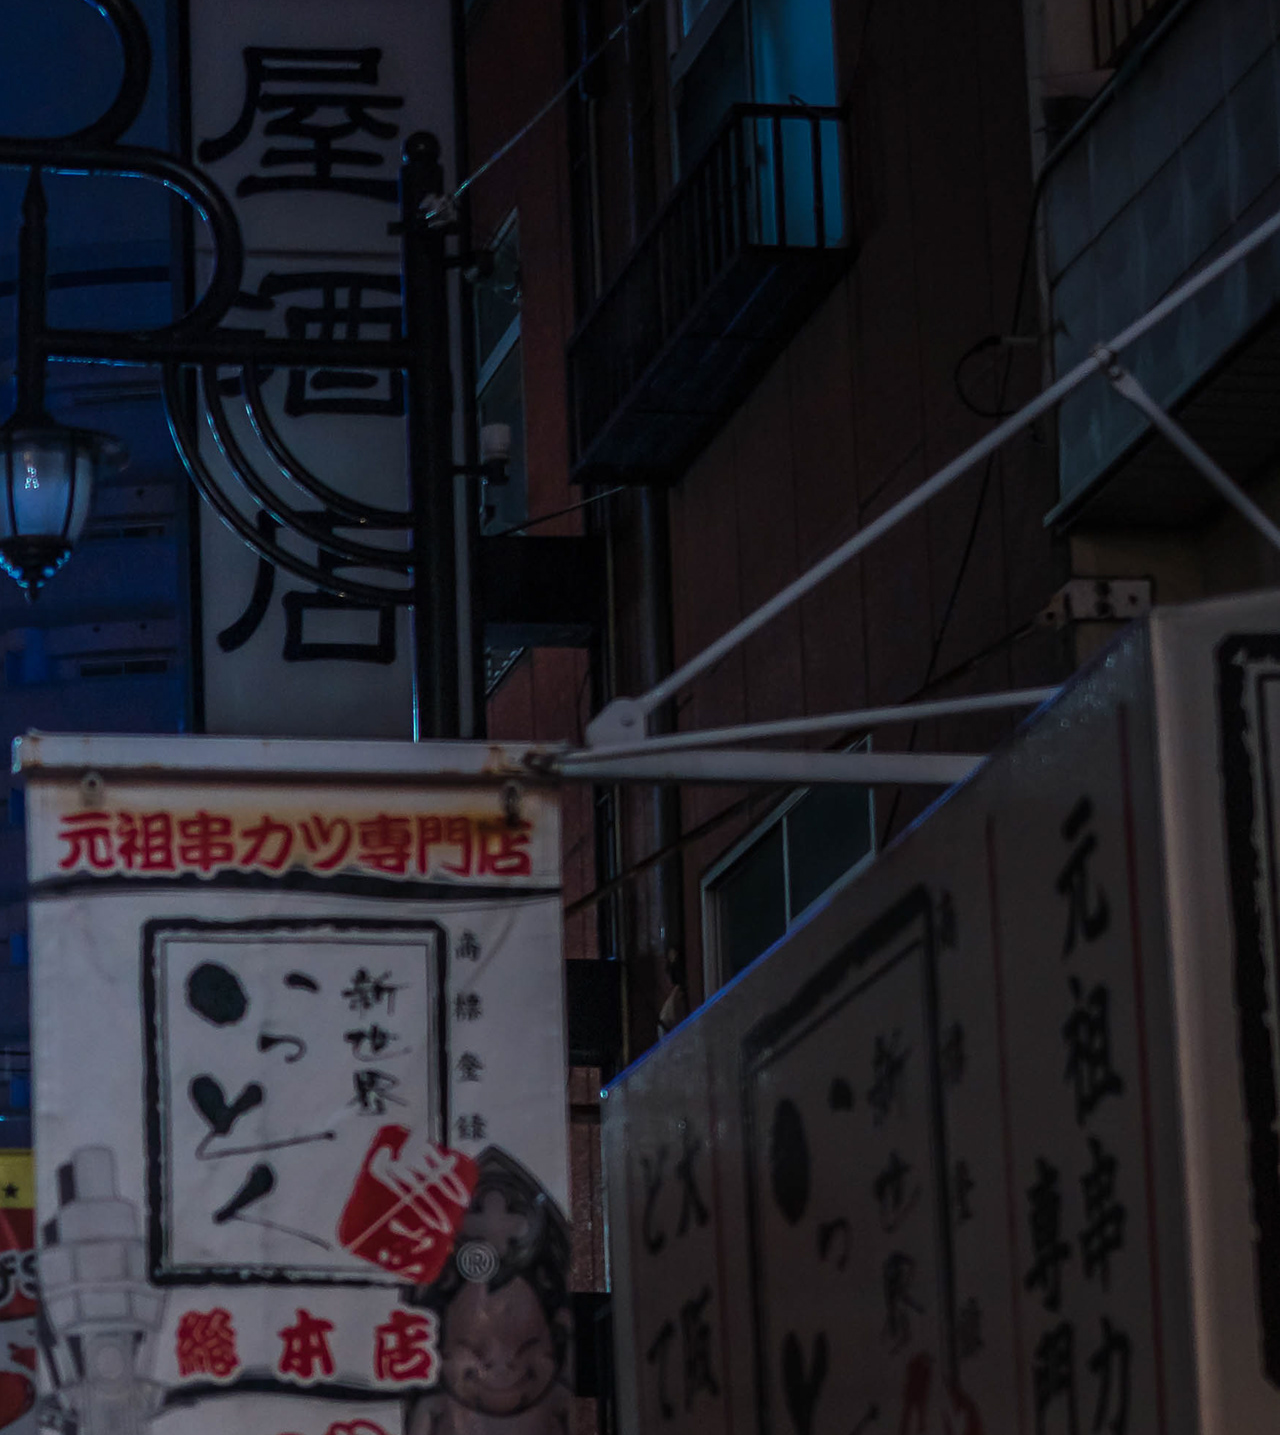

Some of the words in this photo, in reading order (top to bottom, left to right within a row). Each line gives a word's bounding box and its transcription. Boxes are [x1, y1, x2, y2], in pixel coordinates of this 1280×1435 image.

[58, 811, 533, 876] 元祖串カツ専門店
[343, 968, 410, 1116] 新世界
